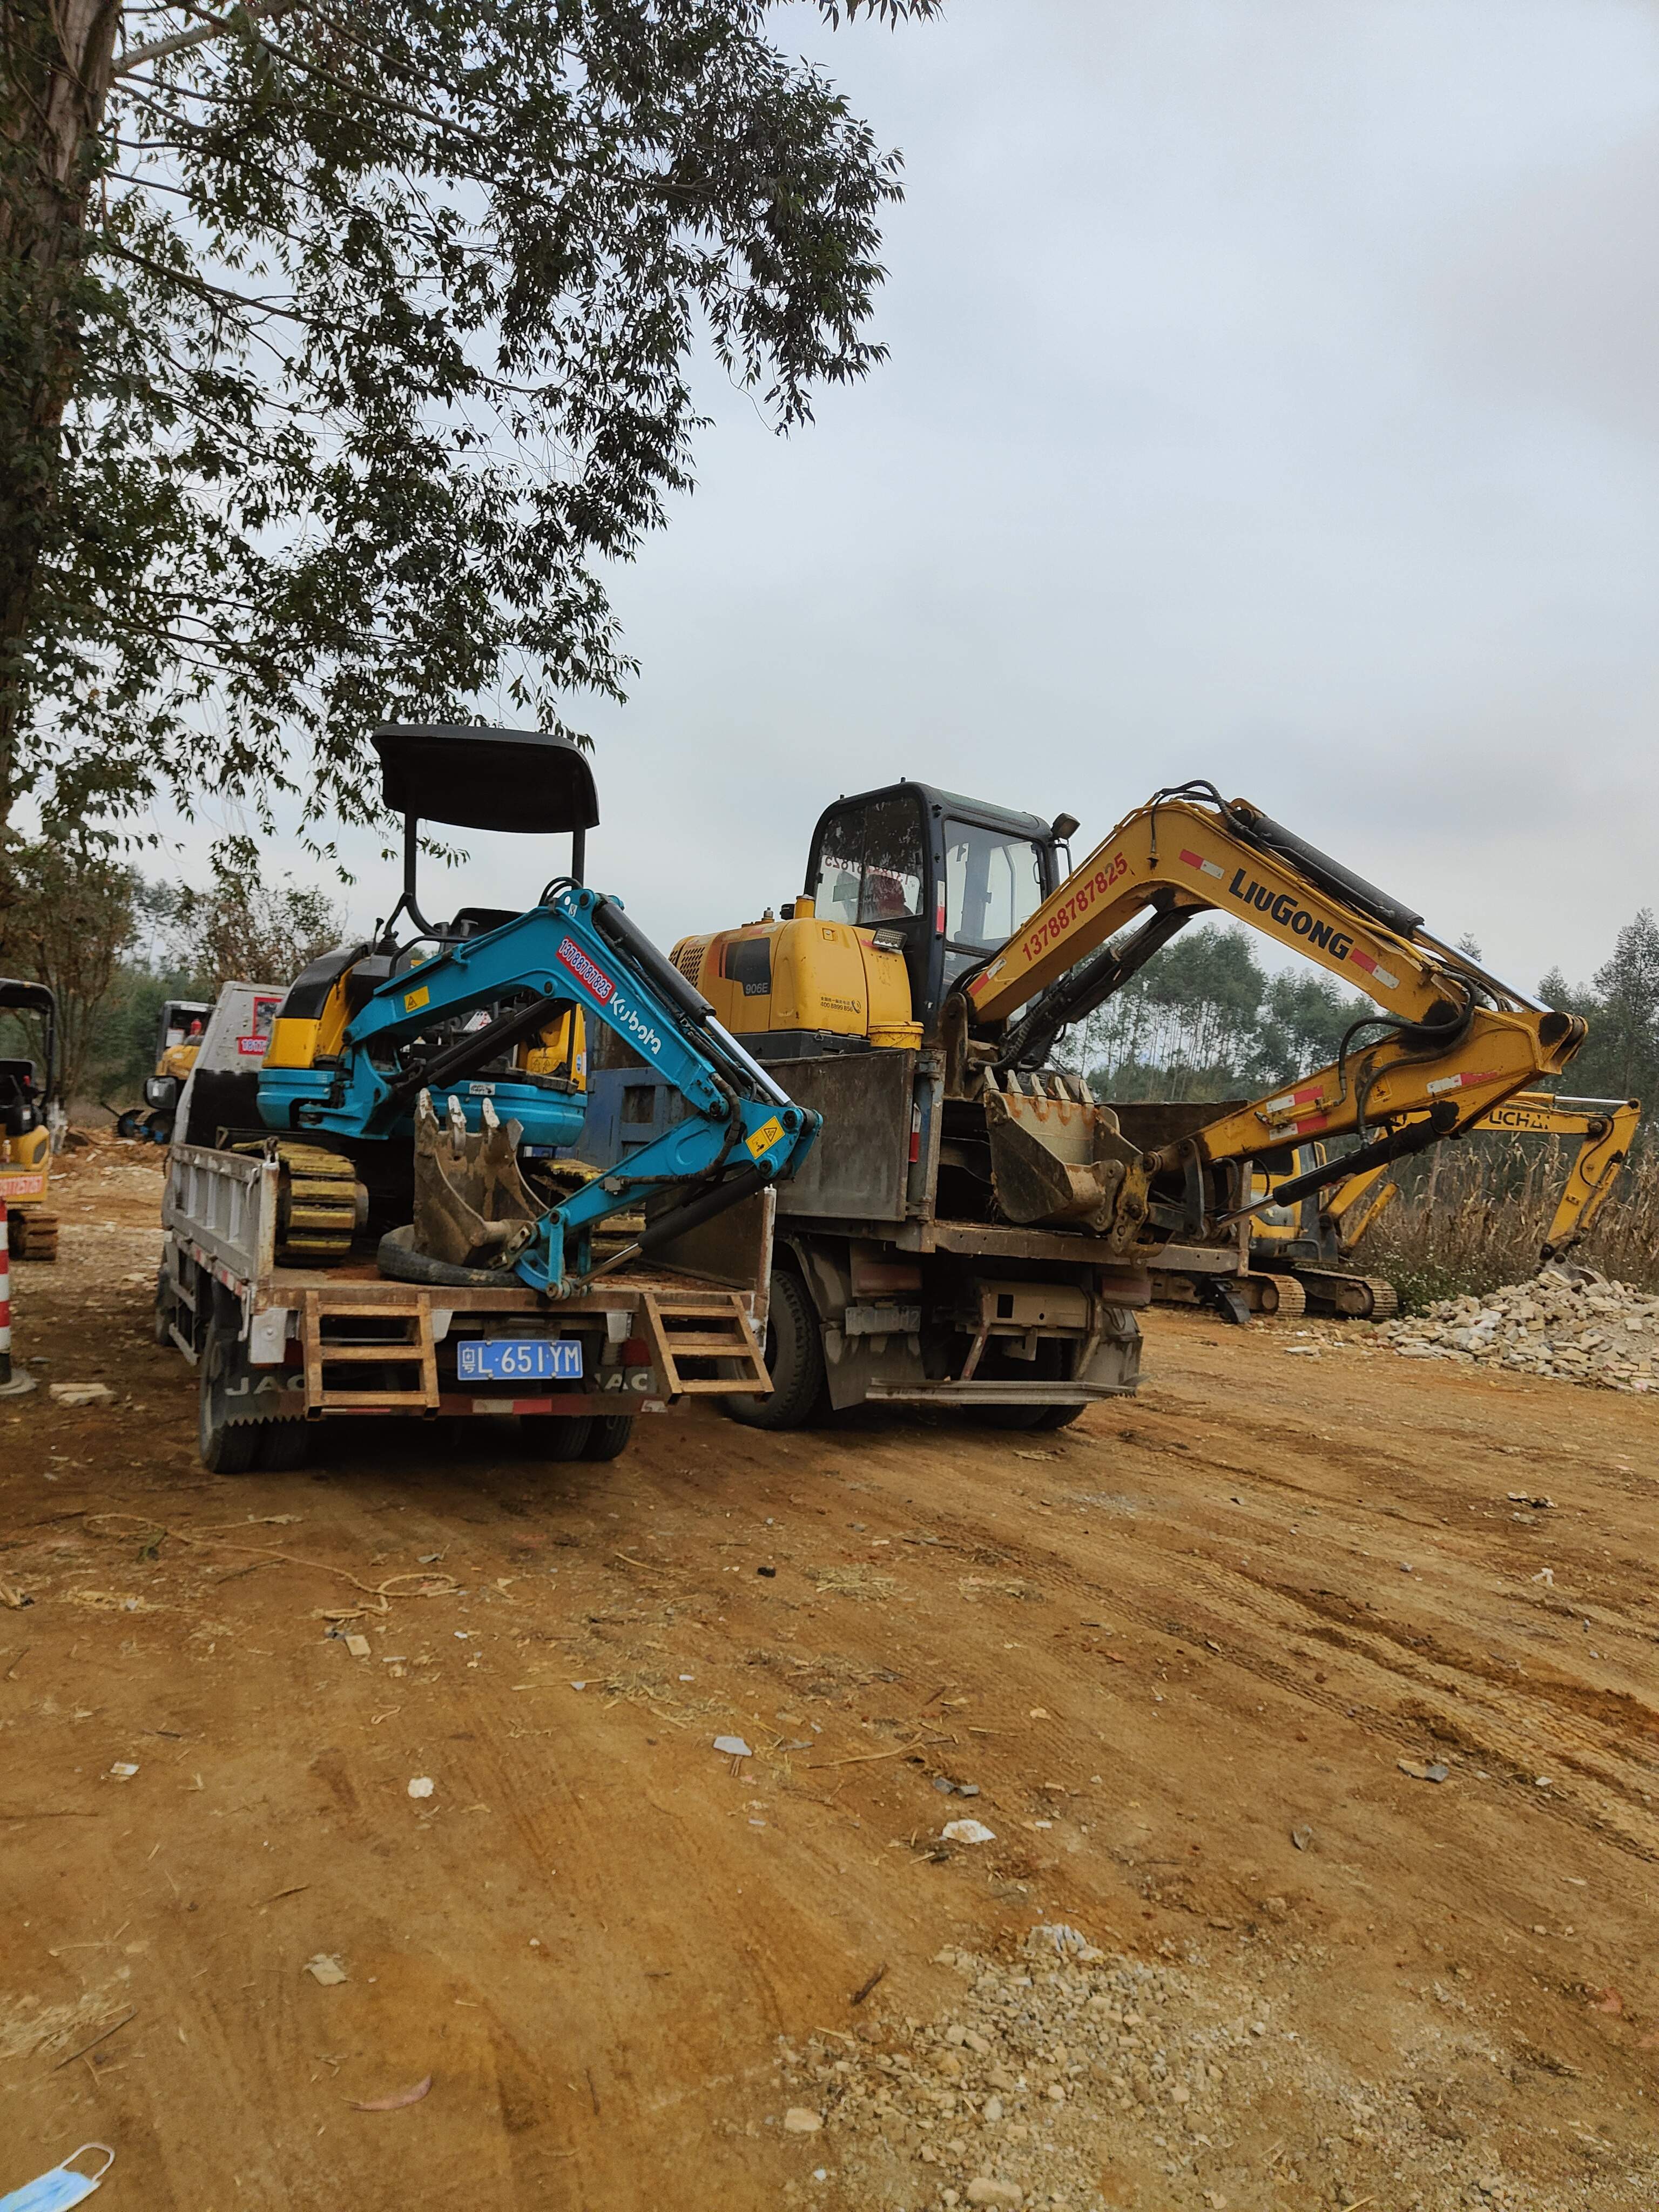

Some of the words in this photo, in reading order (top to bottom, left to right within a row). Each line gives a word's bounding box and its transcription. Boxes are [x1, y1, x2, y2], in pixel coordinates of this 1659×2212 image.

[1023, 852, 1128, 961] 13788787825
[559, 939, 612, 999] 13788787825
[746, 982, 768, 994] 906E
[610, 992, 661, 1054] Kubota
